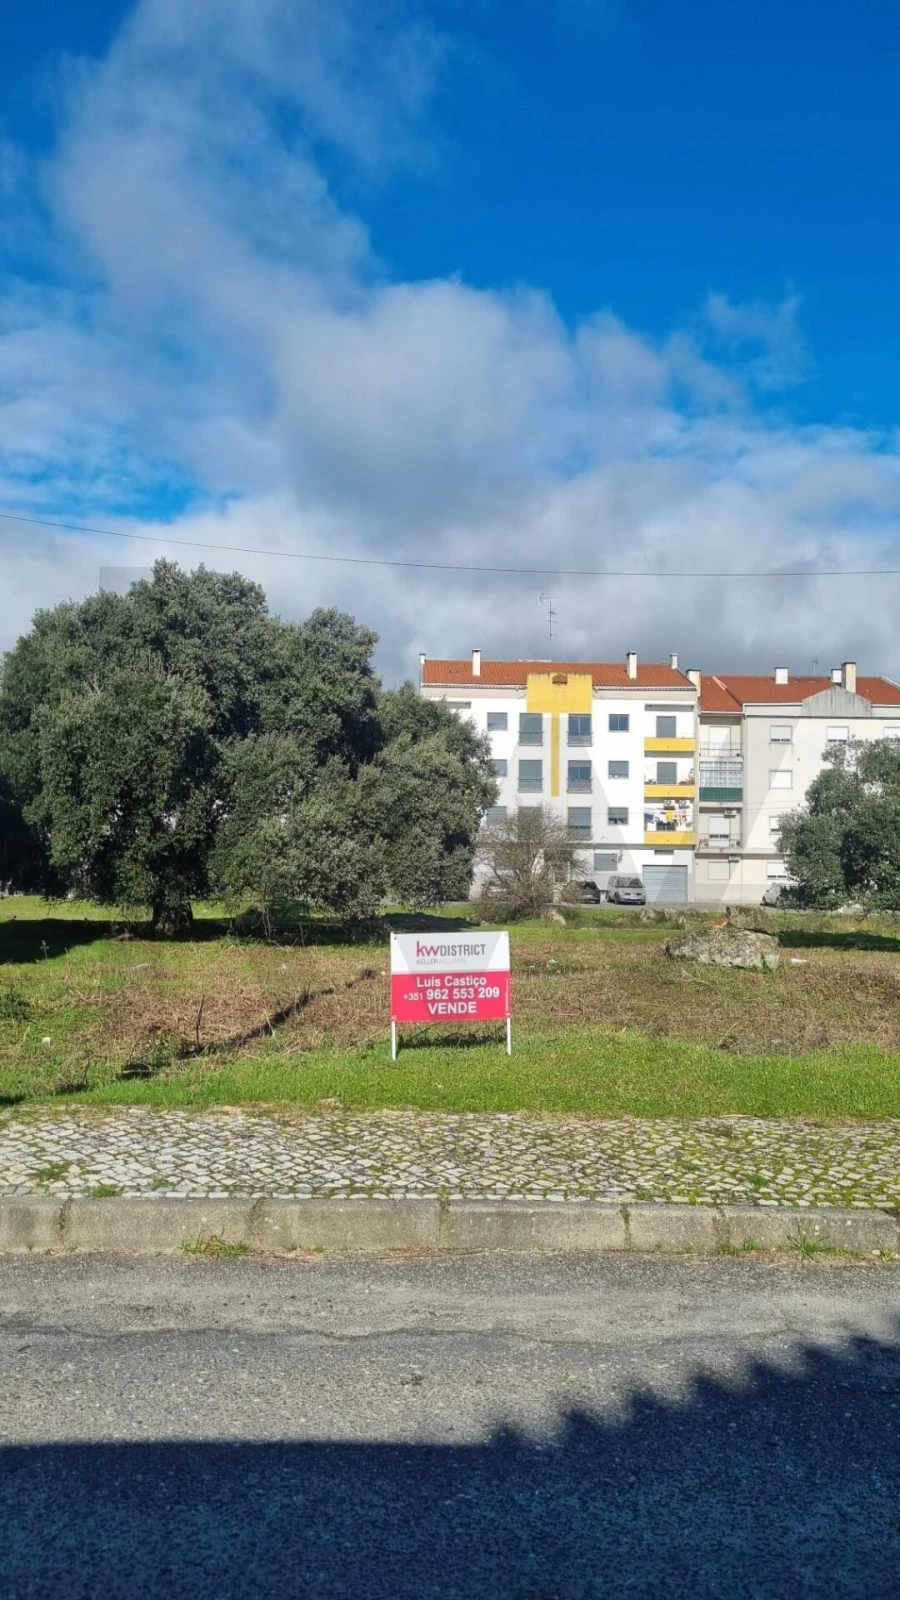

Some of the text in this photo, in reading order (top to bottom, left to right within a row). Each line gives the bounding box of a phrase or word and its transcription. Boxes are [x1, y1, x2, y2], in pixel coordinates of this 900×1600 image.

[444, 975, 487, 988] Castiço
[403, 986, 500, 1001] +351 962 553 209
[428, 1001, 477, 1015] VENDE
